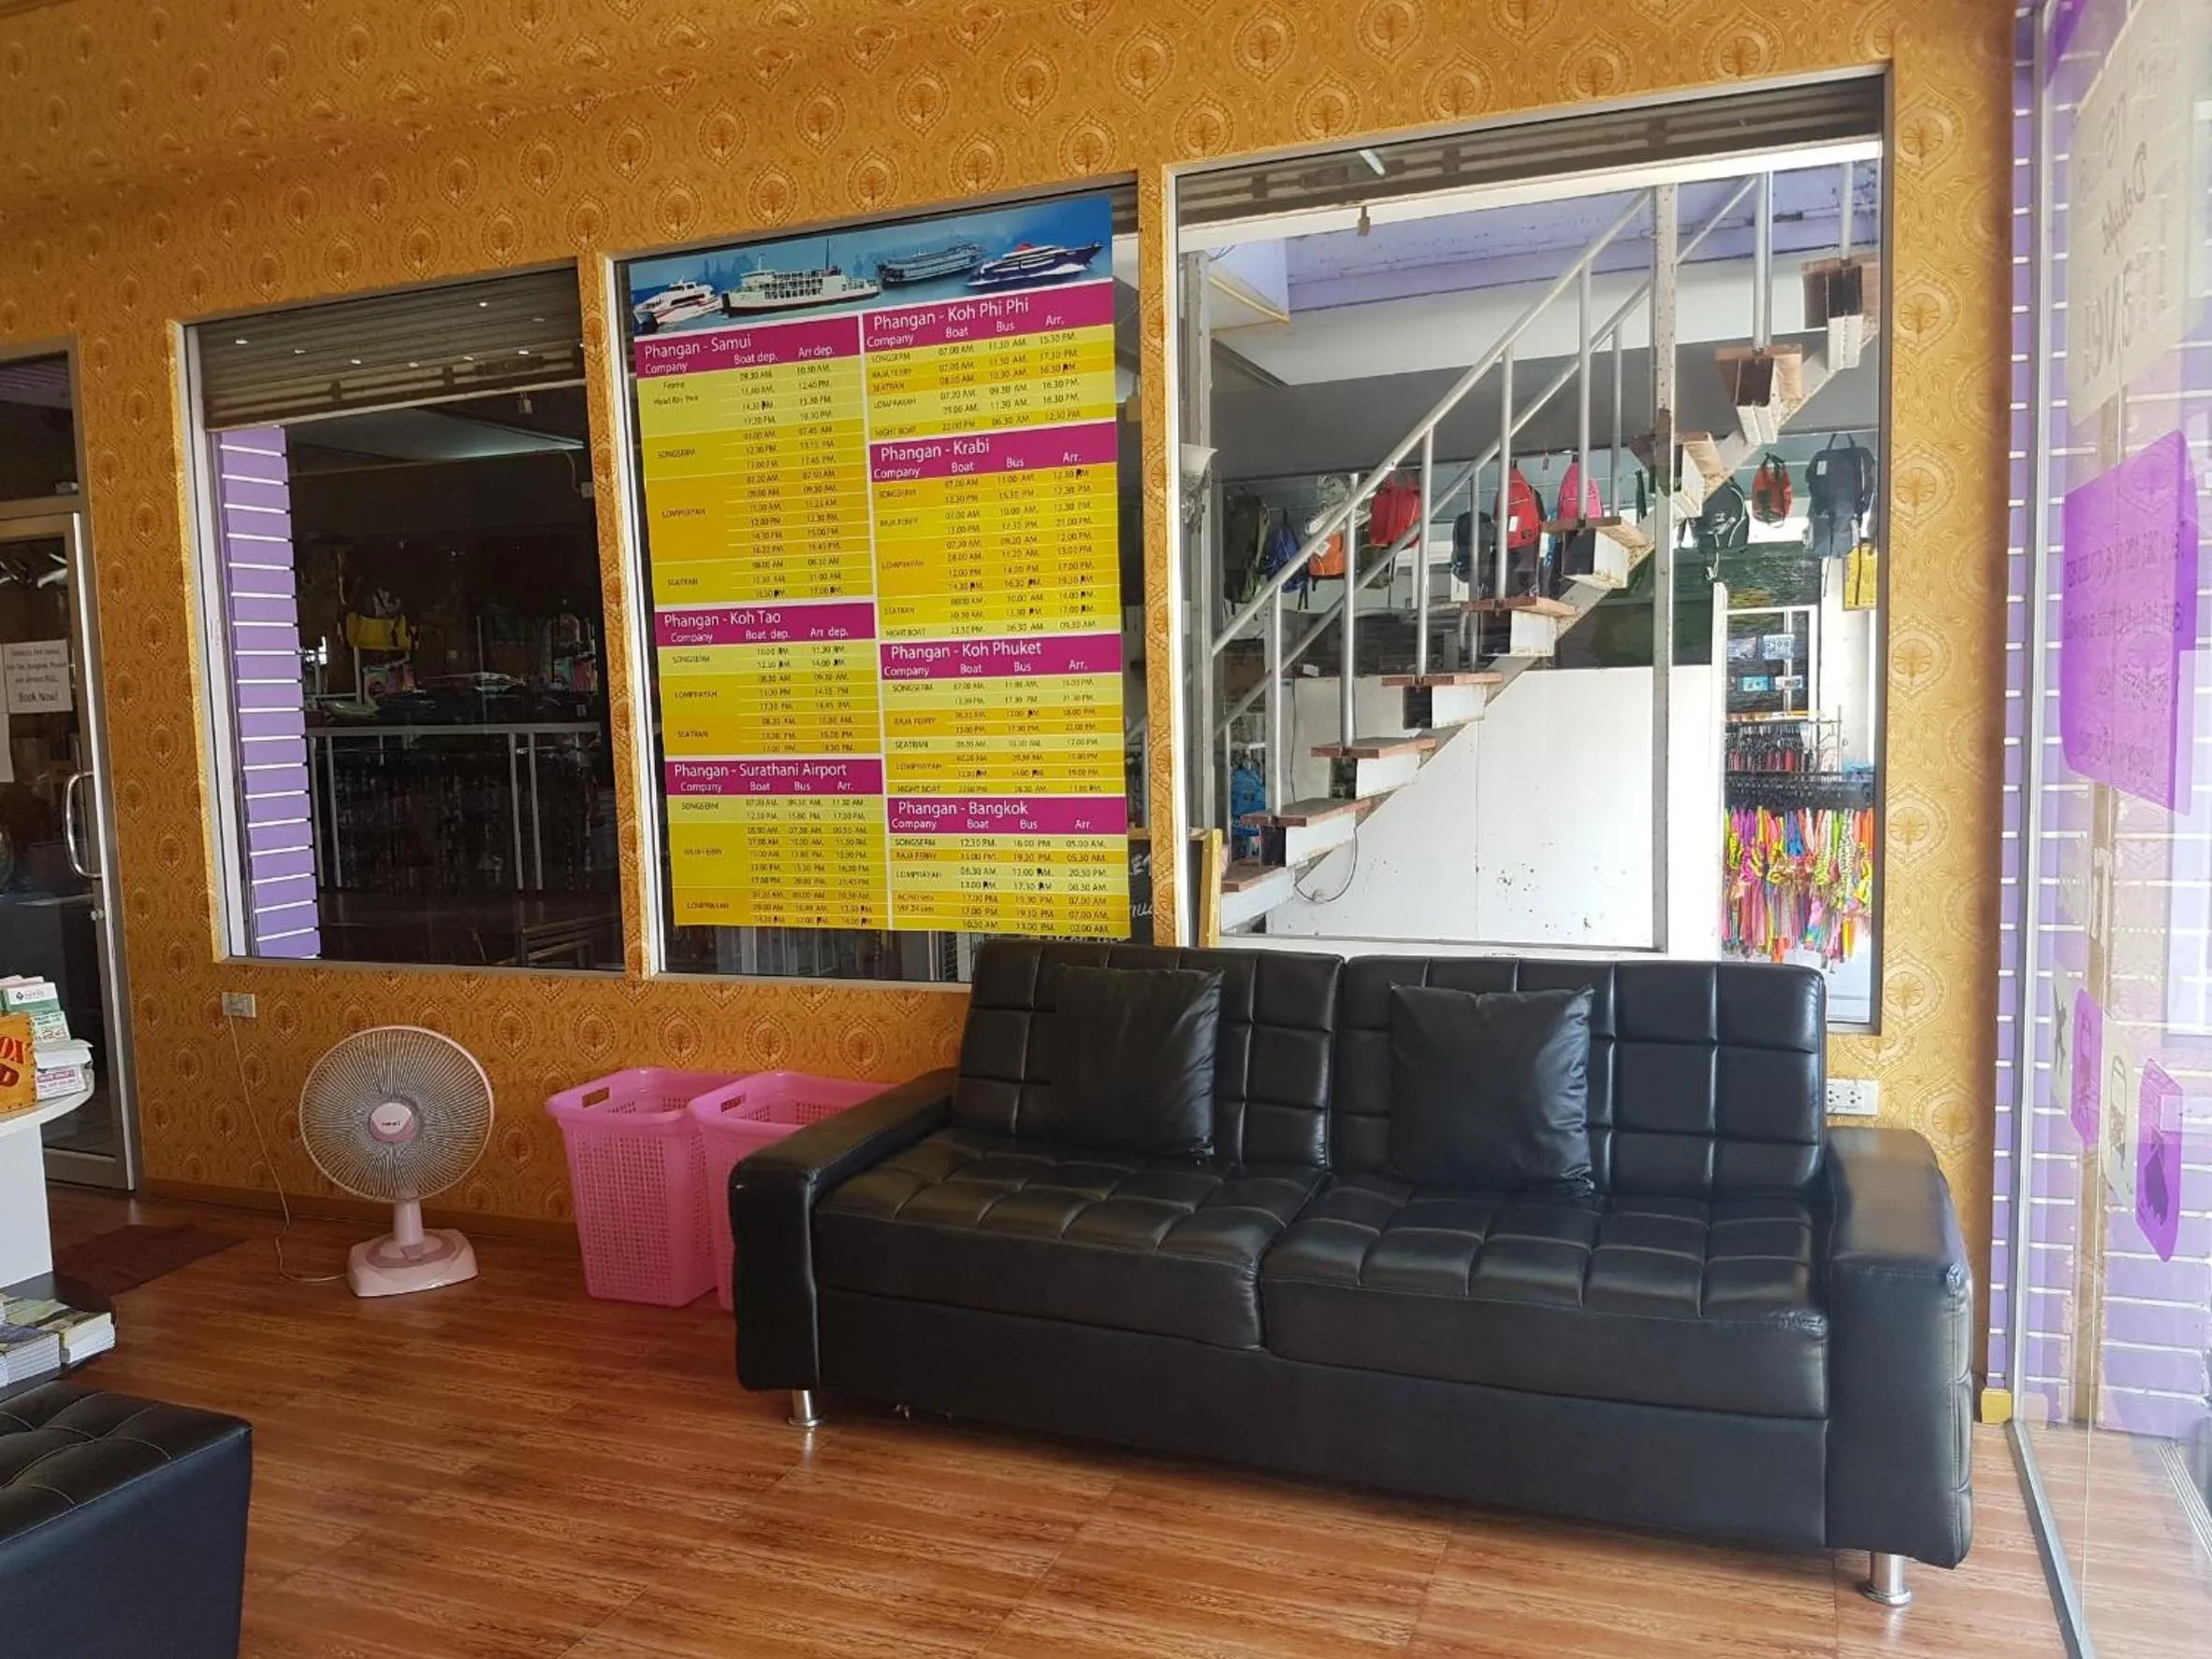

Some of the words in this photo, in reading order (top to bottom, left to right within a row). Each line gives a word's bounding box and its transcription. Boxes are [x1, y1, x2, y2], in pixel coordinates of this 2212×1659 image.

[874, 313, 935, 331] Phangan
[948, 306, 975, 322] Koh
[980, 302, 1002, 318] Phi
[1007, 298, 1028, 315] Phi
[867, 333, 913, 347] Company
[945, 327, 968, 338] Boat
[997, 321, 1014, 332] Bus
[1046, 314, 1064, 327] Arr.
[645, 343, 700, 359] Phangan
[711, 336, 751, 351] Samui
[646, 362, 688, 375] Company
[735, 355, 755, 365] Boat
[757, 352, 778, 364] dep.
[798, 346, 813, 357] Arr
[881, 444, 940, 462] Phangan
[954, 439, 989, 455] Krabi
[874, 467, 920, 479] Company
[952, 462, 974, 473] Boat
[1007, 457, 1024, 468] Bus
[1063, 452, 1081, 462] Arr.
[664, 615, 719, 630] Phangan
[731, 612, 755, 625] Koh
[758, 610, 780, 623] Tao
[671, 633, 712, 643] Company
[746, 631, 765, 639] Boat
[771, 631, 791, 639] dep.
[810, 628, 824, 637] Arr
[828, 627, 849, 636] dep.
[892, 646, 950, 661] Phangan
[962, 643, 988, 656] Koh
[993, 642, 1041, 655] Phuket
[884, 666, 929, 677] Company
[960, 664, 982, 674] Boat
[1014, 662, 1031, 672] Bus
[1070, 661, 1087, 670] Arr.
[675, 764, 728, 779] Phangan
[739, 764, 798, 776] Surathani
[803, 764, 847, 778] Airport
[680, 782, 721, 793] Company
[750, 782, 770, 791] Boat
[795, 782, 810, 791] Bus
[837, 781, 853, 791] Arr.
[899, 803, 956, 817] Phangan
[969, 802, 1027, 817] Bangkok
[892, 819, 936, 829] Company
[967, 820, 988, 829] Boat
[1020, 820, 1038, 829] Bus
[1075, 820, 1092, 829] Arr.
